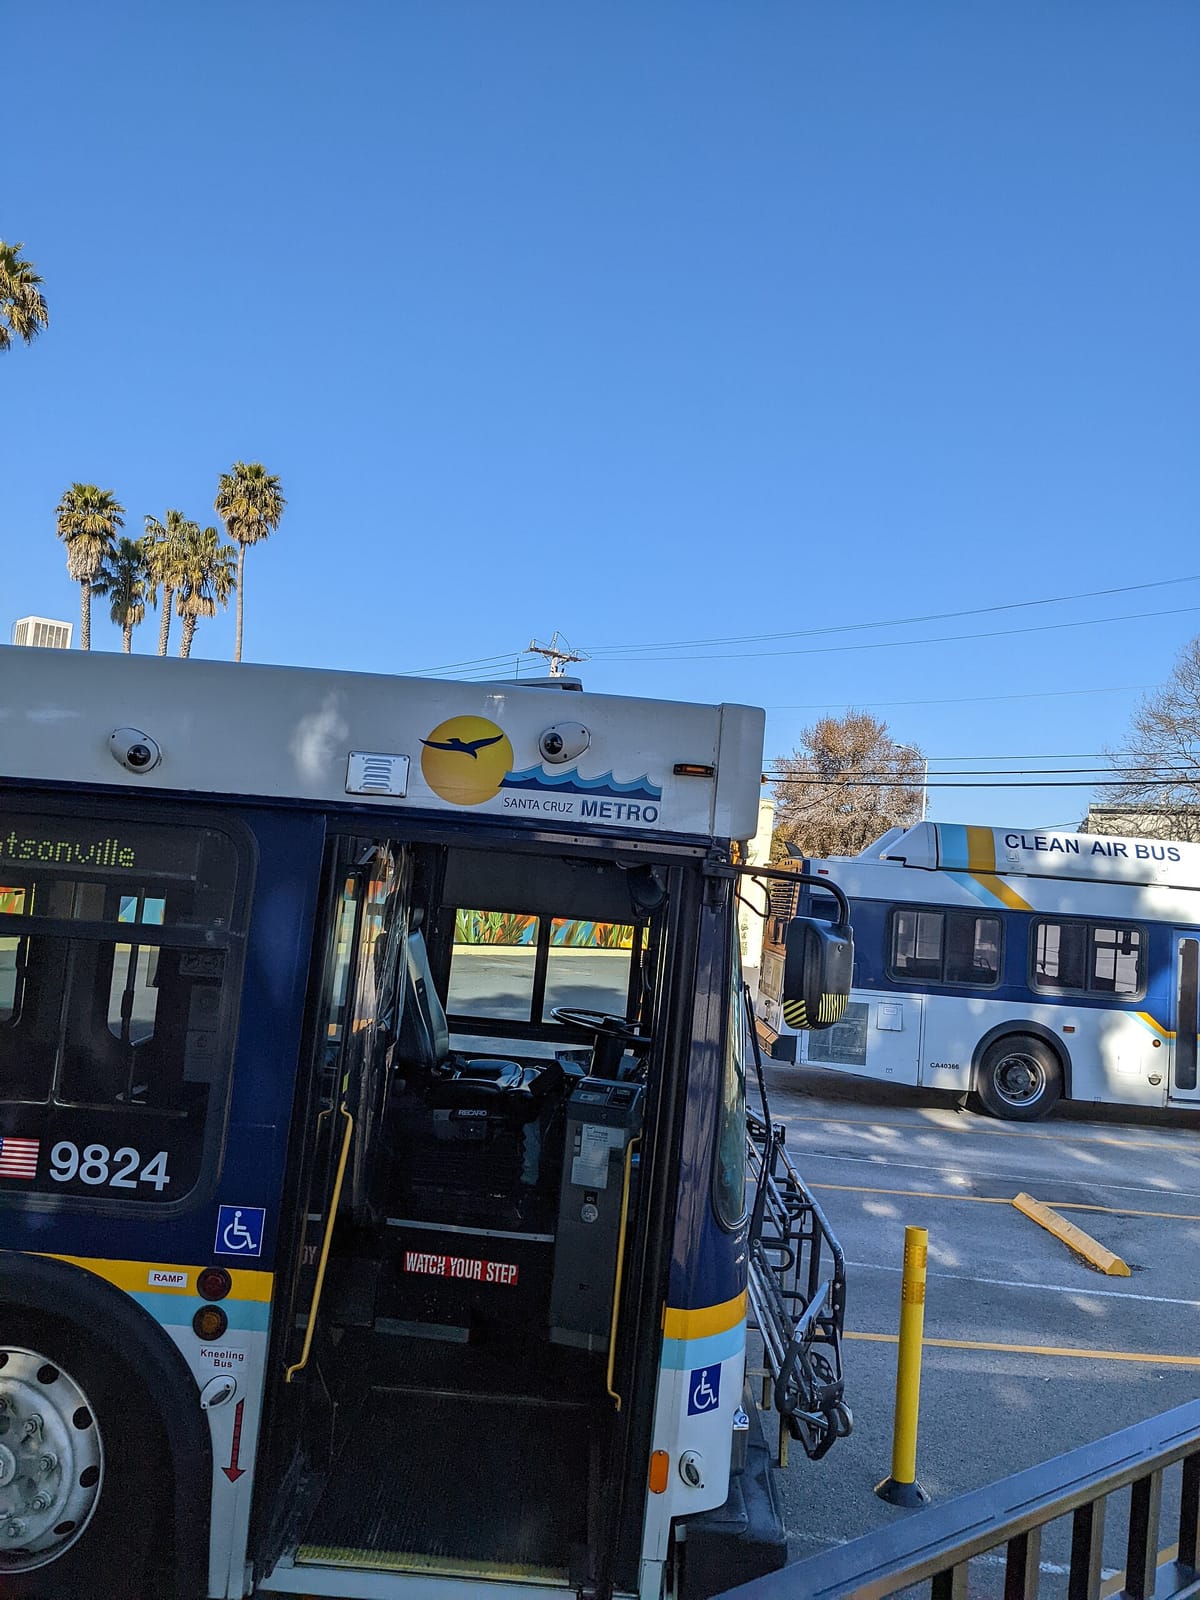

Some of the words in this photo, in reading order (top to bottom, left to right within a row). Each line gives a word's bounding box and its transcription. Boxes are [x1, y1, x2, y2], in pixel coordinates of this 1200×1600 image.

[503, 797, 540, 810] SANTA
[543, 801, 574, 813] CRUZ
[581, 799, 659, 823] METRO
[0, 831, 135, 867] tsonville
[1004, 833, 1080, 854] CLEAN
[1090, 840, 1129, 858] AIR
[1135, 843, 1181, 862] BUS
[49, 1140, 171, 1191] 9824
[153, 1273, 184, 1283] RAMP
[405, 1251, 446, 1275] WATCH
[450, 1257, 482, 1280] YOUR
[486, 1261, 517, 1284] STEP
[200, 1348, 244, 1361] Kneeling
[213, 1359, 233, 1368] Bus
